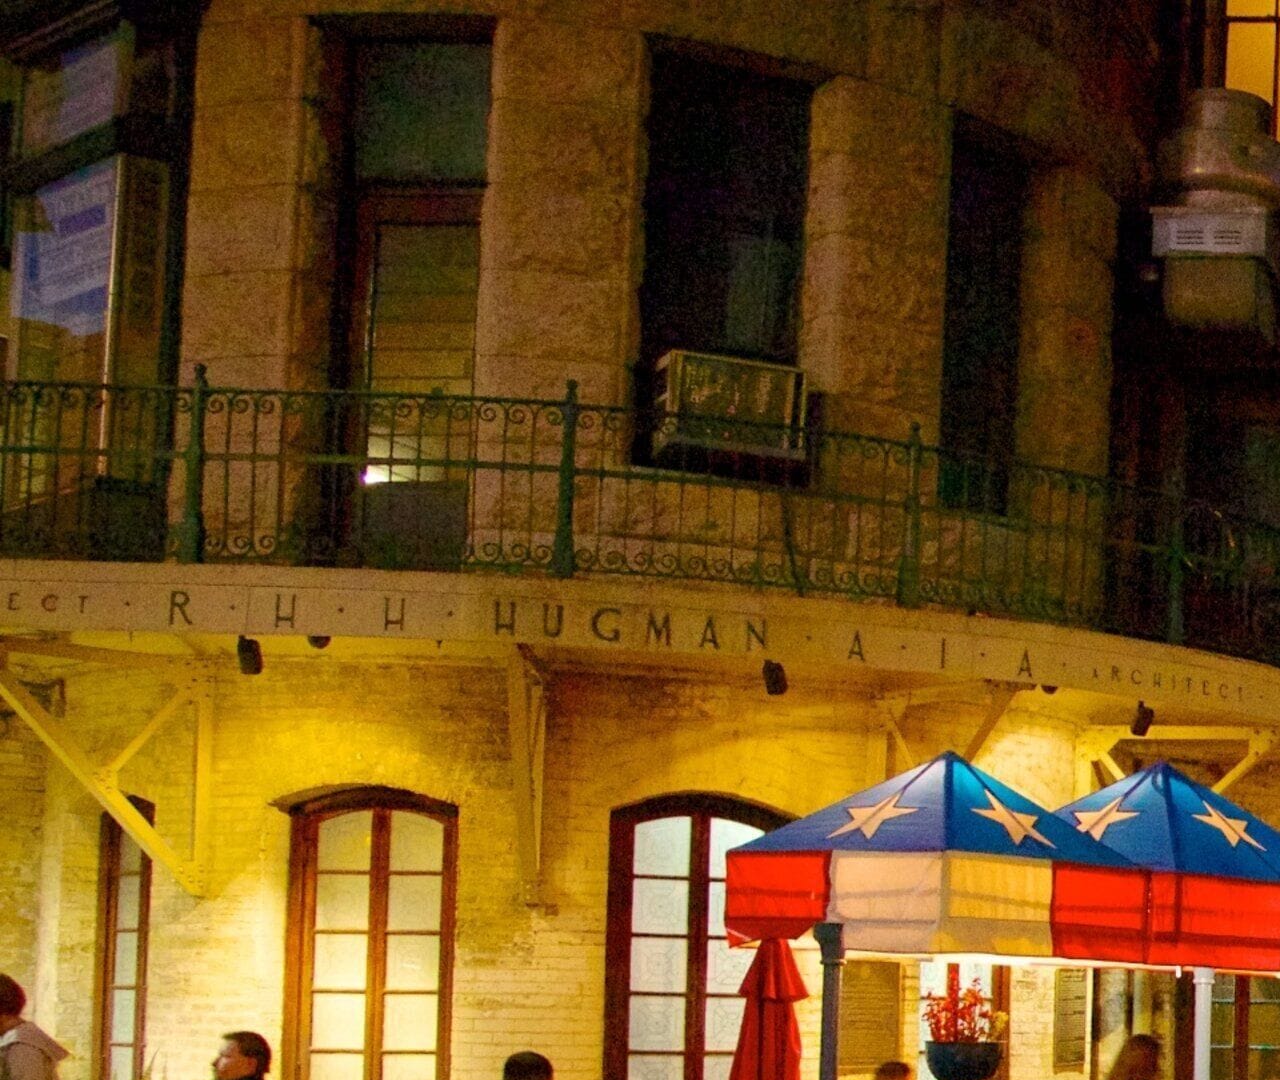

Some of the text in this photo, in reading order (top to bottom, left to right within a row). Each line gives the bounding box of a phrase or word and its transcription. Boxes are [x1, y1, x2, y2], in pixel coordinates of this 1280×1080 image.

[167, 589, 194, 626] R
[273, 593, 297, 629] H
[383, 597, 406, 632] H
[493, 600, 769, 651] HUGMAN
[846, 630, 867, 663] A
[1016, 649, 1034, 679] A
[1091, 664, 1245, 700] ARCHITECT
